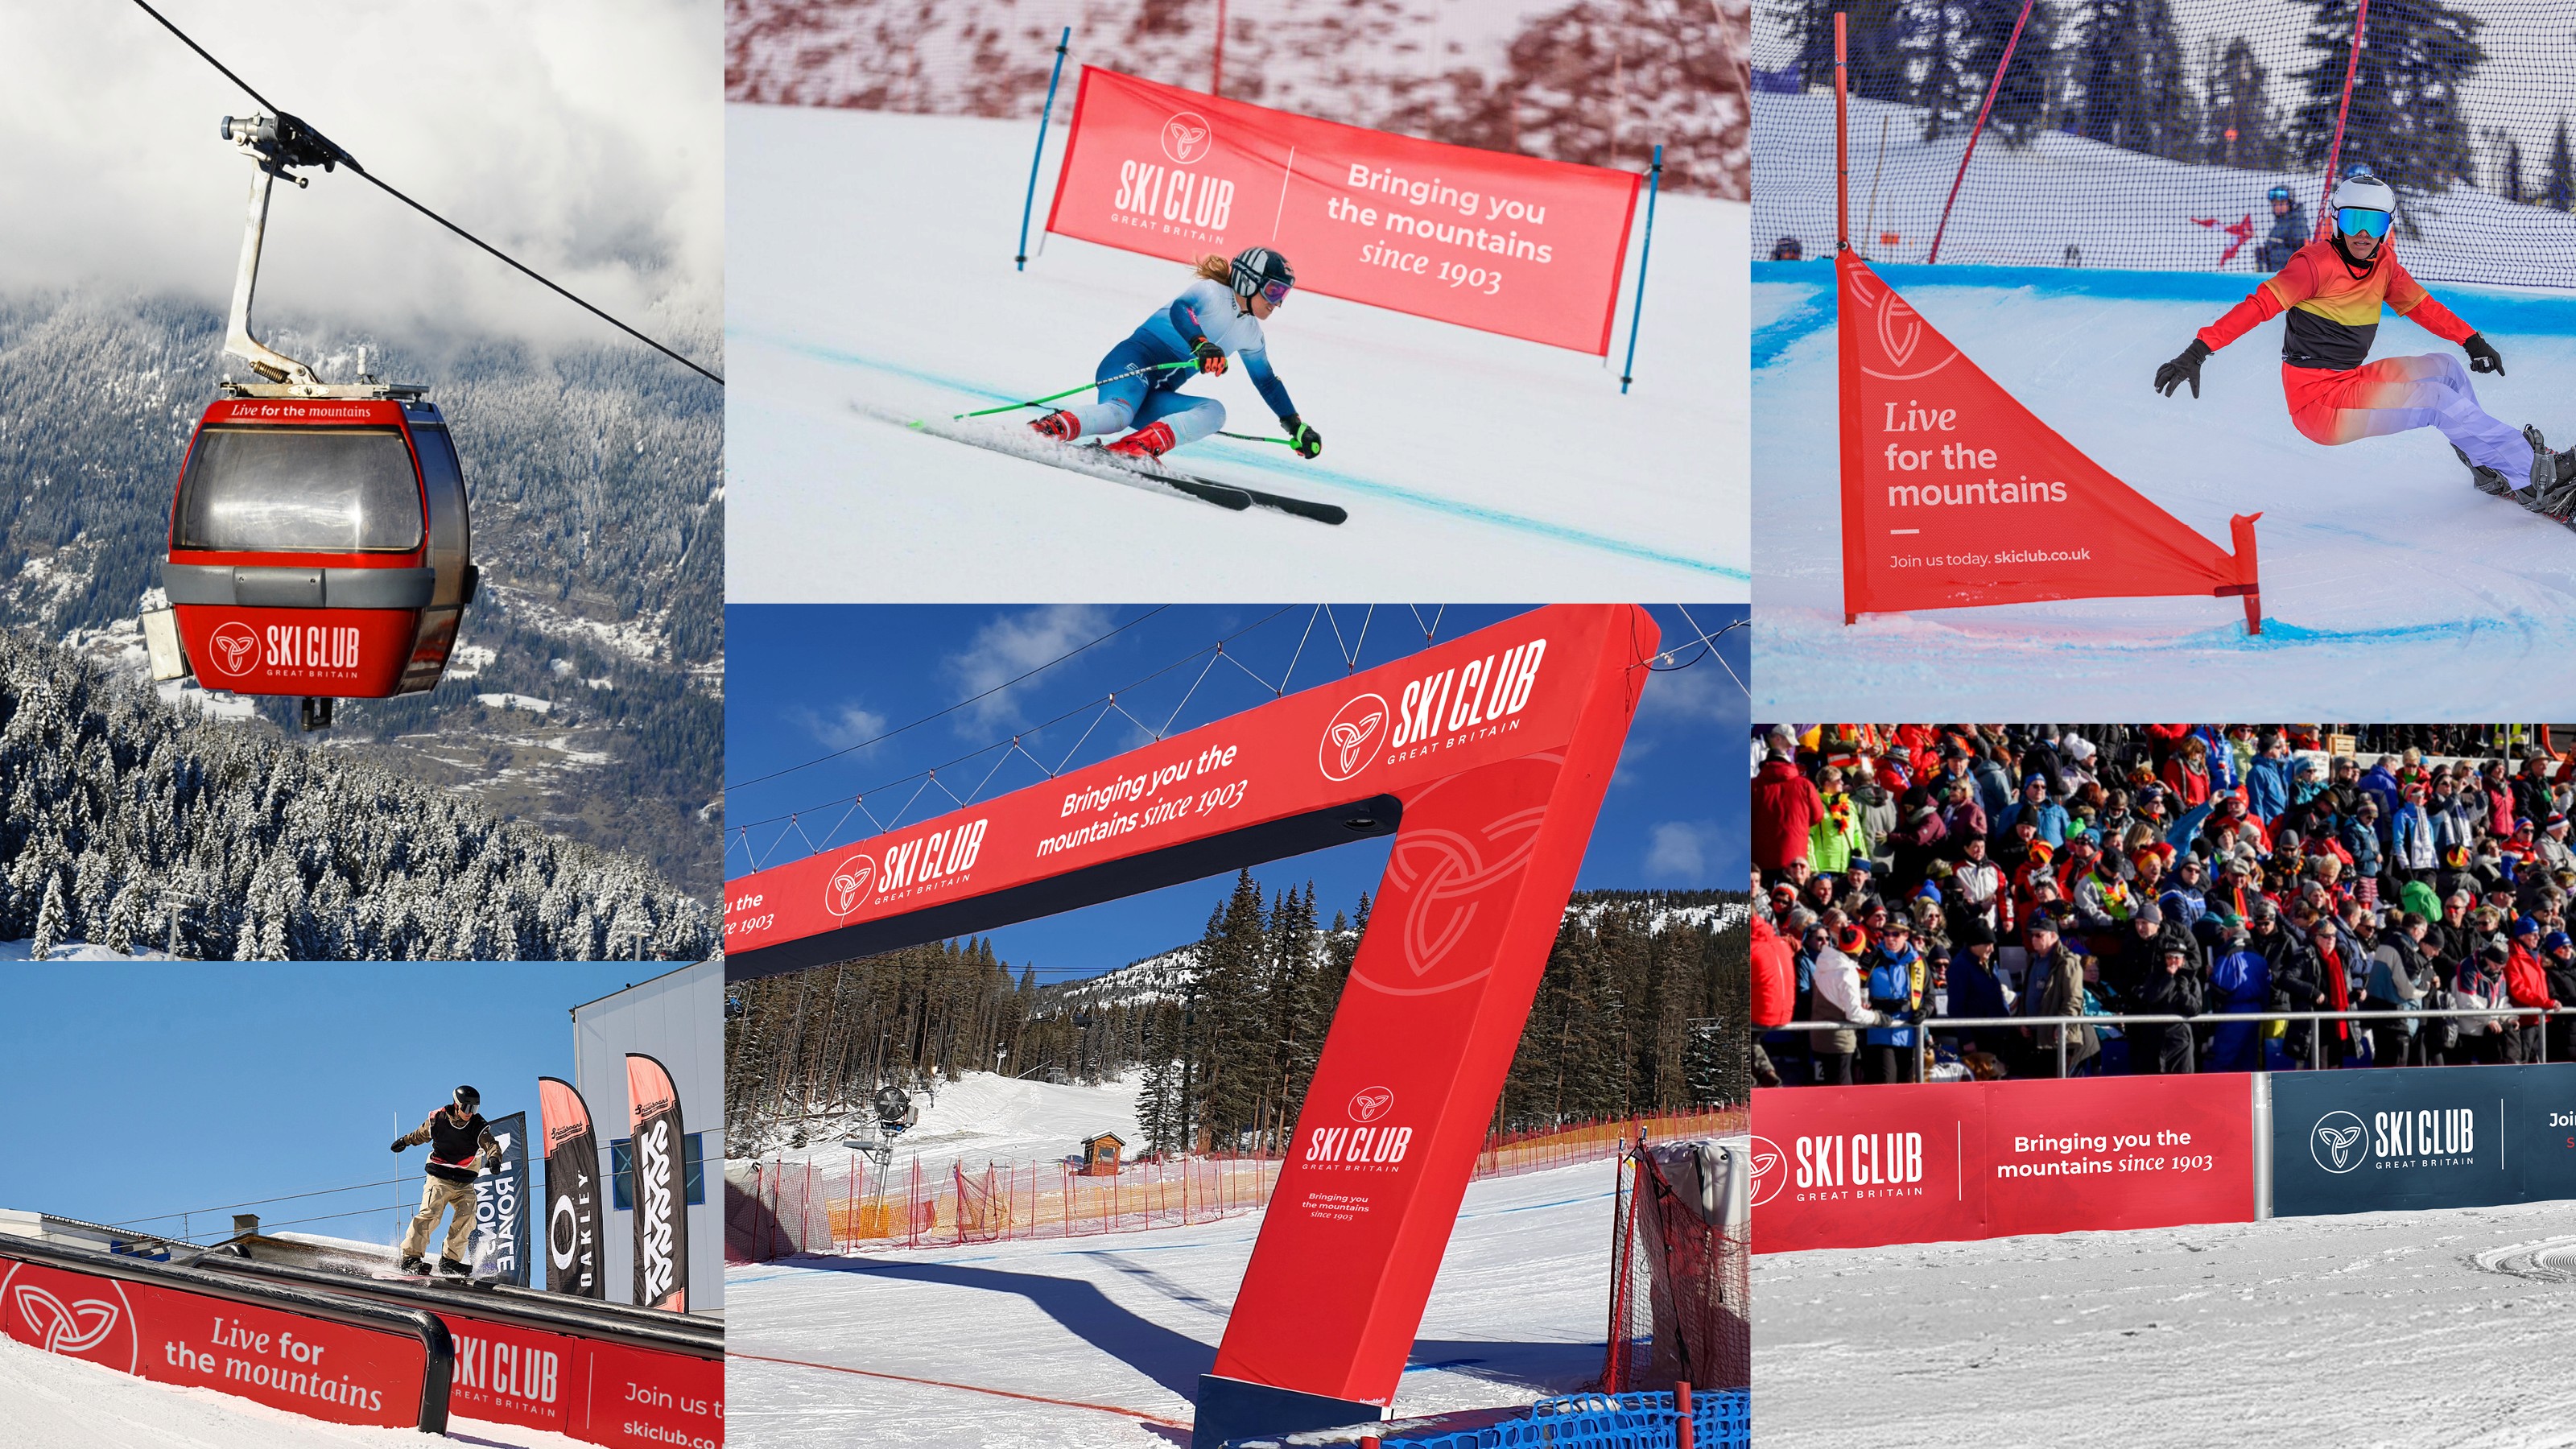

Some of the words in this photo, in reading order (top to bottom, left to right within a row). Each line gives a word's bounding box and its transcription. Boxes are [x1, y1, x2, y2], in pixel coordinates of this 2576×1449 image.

[1114, 159, 1165, 217] SKI
[1163, 170, 1235, 231] CLUB
[1347, 163, 1480, 217] Bringing
[1485, 196, 1546, 225] you
[1111, 213, 1157, 230] GREAT
[1163, 225, 1224, 246] BRITAIN
[1327, 196, 1378, 226] the
[1385, 211, 1554, 264] mountains
[1359, 240, 1429, 275] since
[1436, 262, 1503, 295] 1903
[230, 404, 258, 417] Live
[261, 405, 280, 416] for
[283, 406, 305, 416] the
[308, 406, 371, 418] mountains
[1883, 399, 1956, 432] Live
[1885, 443, 1933, 471] for
[1941, 442, 1997, 470] the
[1888, 475, 2067, 507] mountains
[1890, 555, 1922, 568] Join
[1926, 556, 1943, 566] us
[1946, 552, 1991, 568] today.
[1994, 547, 2091, 564] skiclub.co.uk
[266, 625, 300, 667] SKI
[306, 626, 360, 668] CLUB
[266, 669, 303, 677] GREAT
[309, 671, 358, 679] BRITAIN
[1392, 667, 1455, 749] SKI
[1447, 638, 1546, 732] CLUB
[1387, 742, 1439, 765] GREAT
[1446, 718, 1520, 749] BRITAIN
[1060, 773, 1147, 818] Bringing
[1146, 759, 1193, 796] you
[1195, 744, 1237, 775] the
[1036, 811, 1138, 858] mountains
[1140, 795, 1193, 828] since
[1195, 779, 1249, 817] 1903
[878, 838, 923, 894] SKI
[918, 819, 989, 883] CLUB
[737, 894, 763, 911] the
[874, 890, 912, 906] GREAT
[916, 873, 971, 894] BRITAIN
[739, 913, 774, 935] 1903
[634, 1096, 669, 1115] Snowboard
[2549, 1111, 2576, 1127] Joi
[551, 1121, 583, 1139] Snowboard
[1306, 1127, 1349, 1161] SKI
[1346, 1127, 1413, 1163] CLUB
[2014, 1132, 2107, 1154] Bringing
[2112, 1133, 2151, 1152] you
[2156, 1129, 2191, 1146] the
[2375, 1111, 2412, 1158] SKI
[2418, 1108, 2474, 1155] CLUB
[1345, 1165, 1399, 1173] BRITAIN
[1796, 1135, 1843, 1188] SKI
[1852, 1132, 1922, 1185] CLUB
[1997, 1157, 2113, 1179] mountains
[2118, 1154, 2165, 1172] since
[2171, 1154, 2213, 1174] 1903
[2376, 1160, 2416, 1170] GREAT
[2422, 1158, 2474, 1167] BRITAIN
[1309, 1192, 1348, 1203] Bringing
[1319, 1203, 1369, 1212] mountains
[1797, 1191, 1848, 1202] GREAT
[1856, 1187, 1922, 1199] BRITAIN
[578, 1173, 592, 1287] OAKLEY
[1310, 1211, 1331, 1219] since
[1333, 1213, 1353, 1221] 1903
[210, 1317, 270, 1354] Live
[279, 1331, 324, 1366] for
[165, 1340, 216, 1373] the
[225, 1357, 382, 1411] mountains
[493, 1342, 559, 1403] CLUB
[452, 1389, 489, 1402] REAT
[496, 1397, 555, 1418] BRITAIN
[624, 1382, 673, 1409] Join
[680, 1397, 708, 1415] us
[713, 1401, 724, 1418] t
